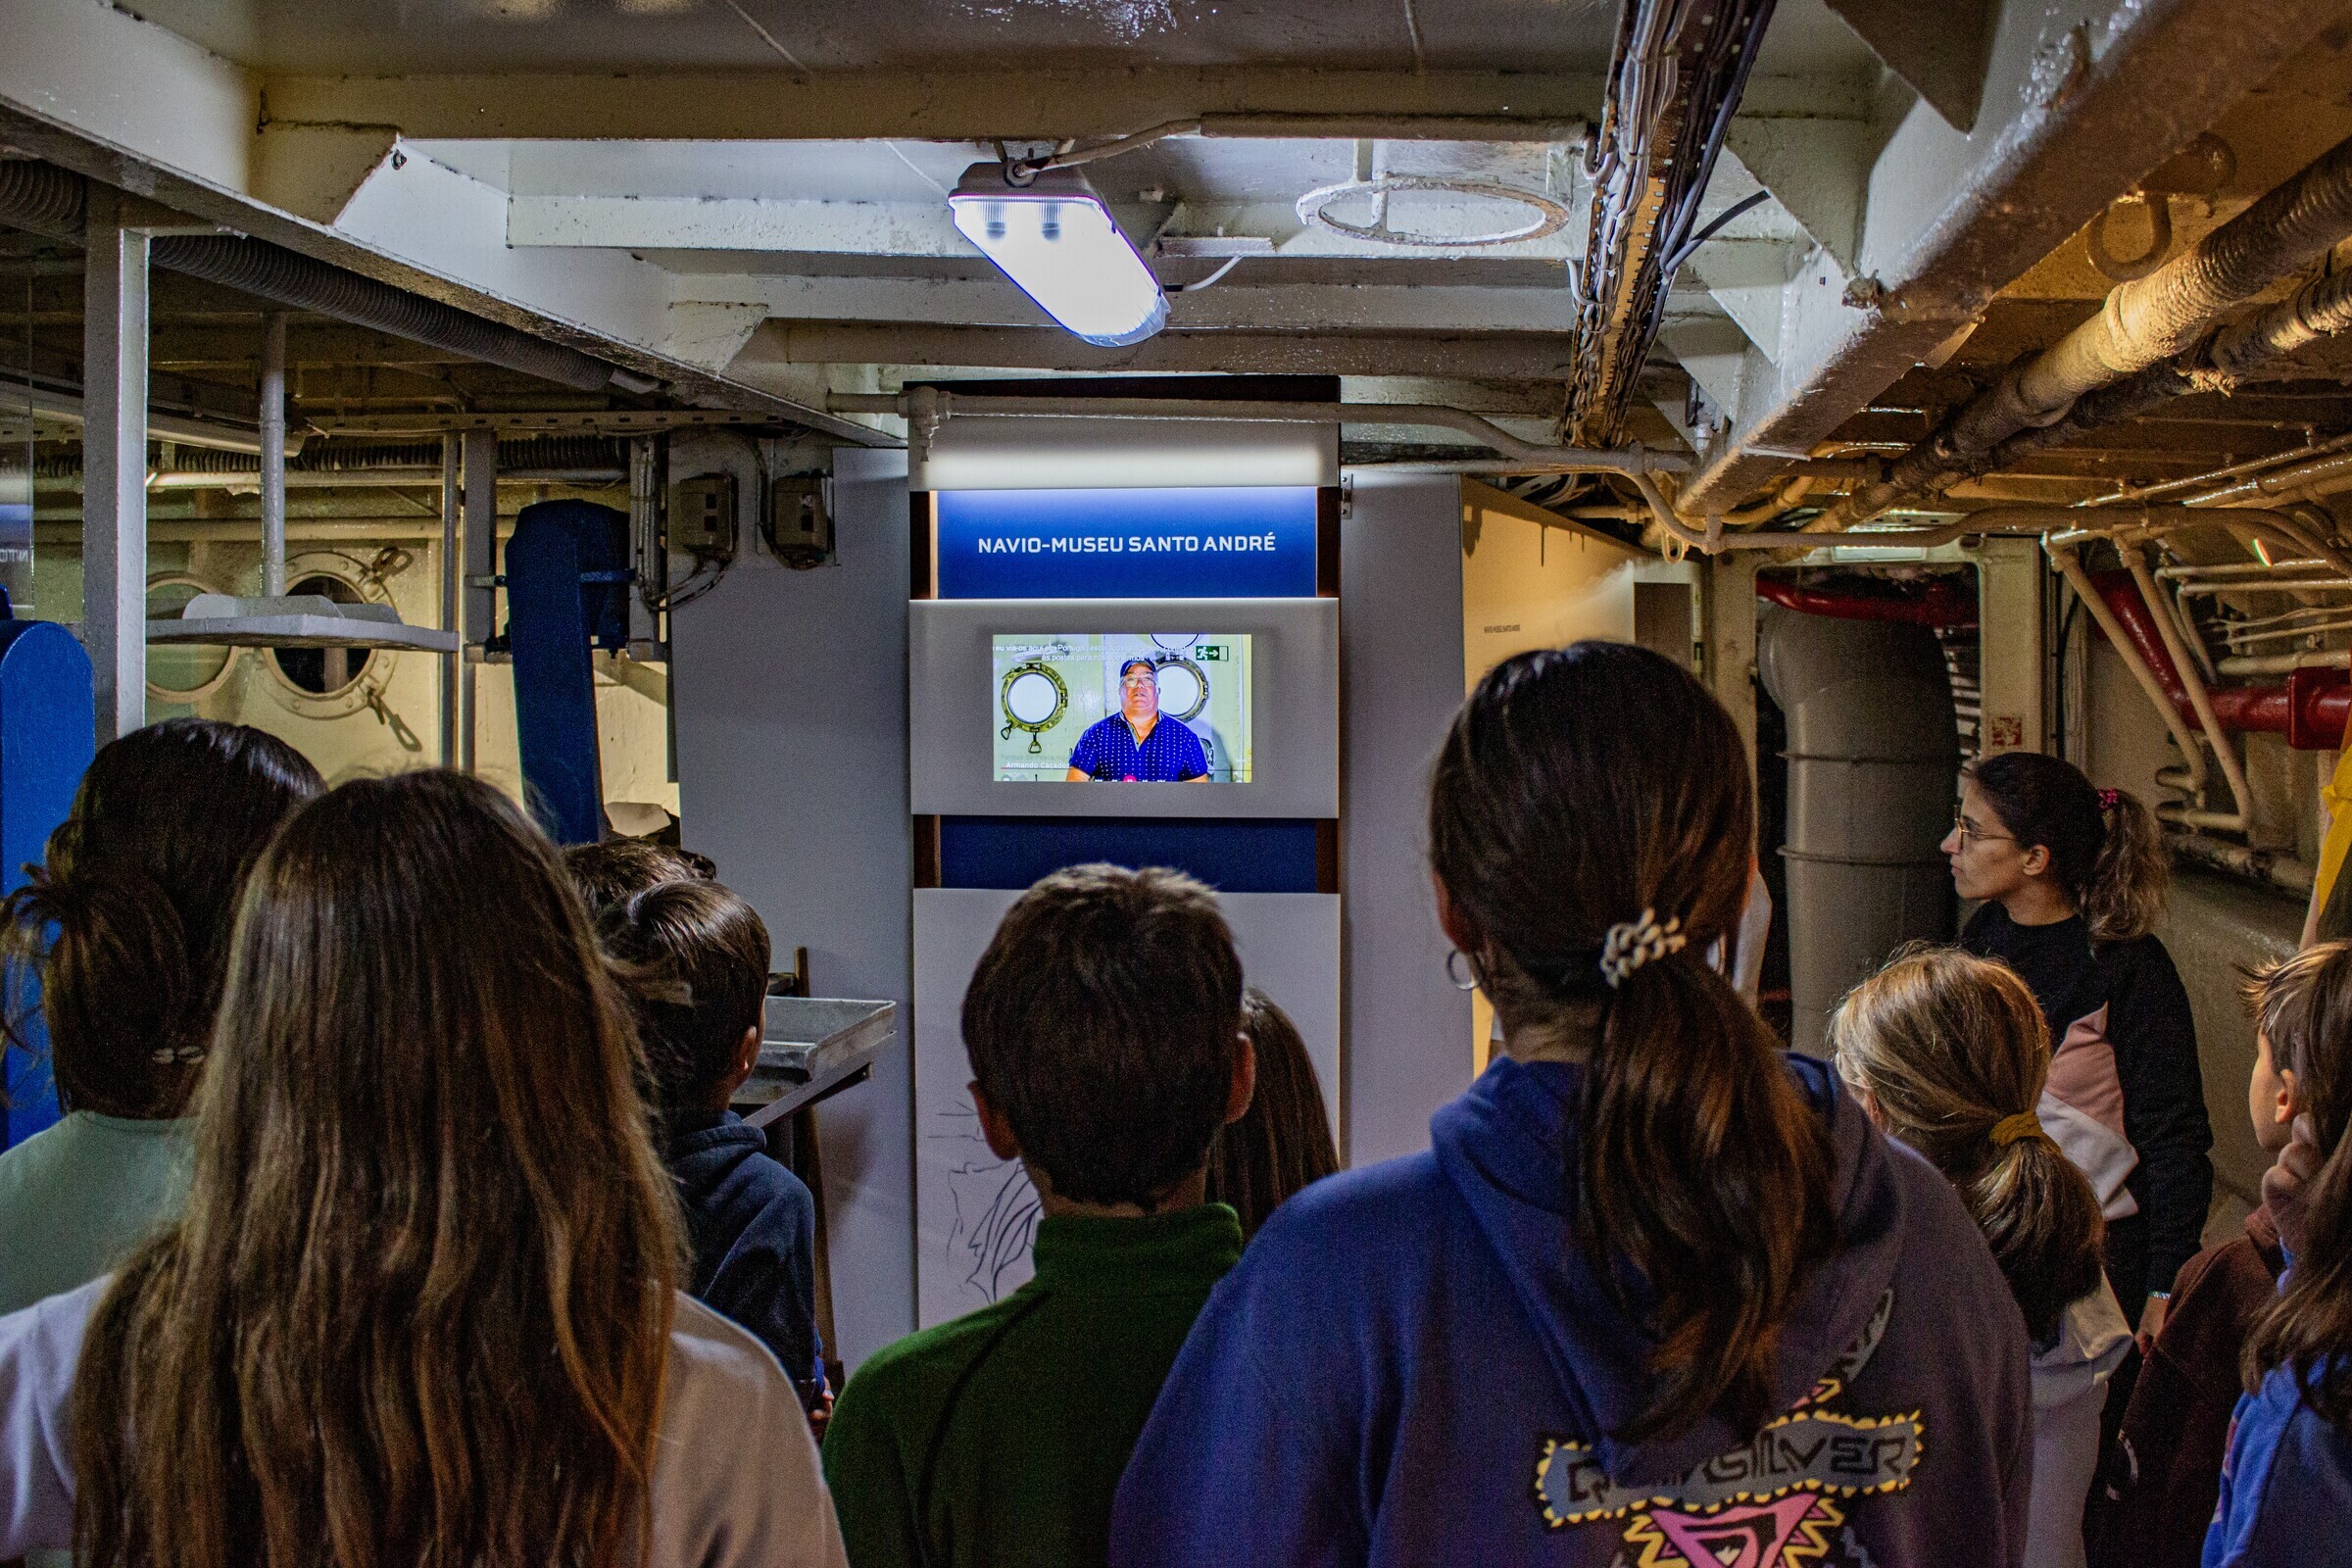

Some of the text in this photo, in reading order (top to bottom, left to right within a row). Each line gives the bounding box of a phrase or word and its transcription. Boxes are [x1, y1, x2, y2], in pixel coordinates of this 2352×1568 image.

[978, 532, 1276, 554] NAVIO-MUSEU SANTO ANDRÉ
